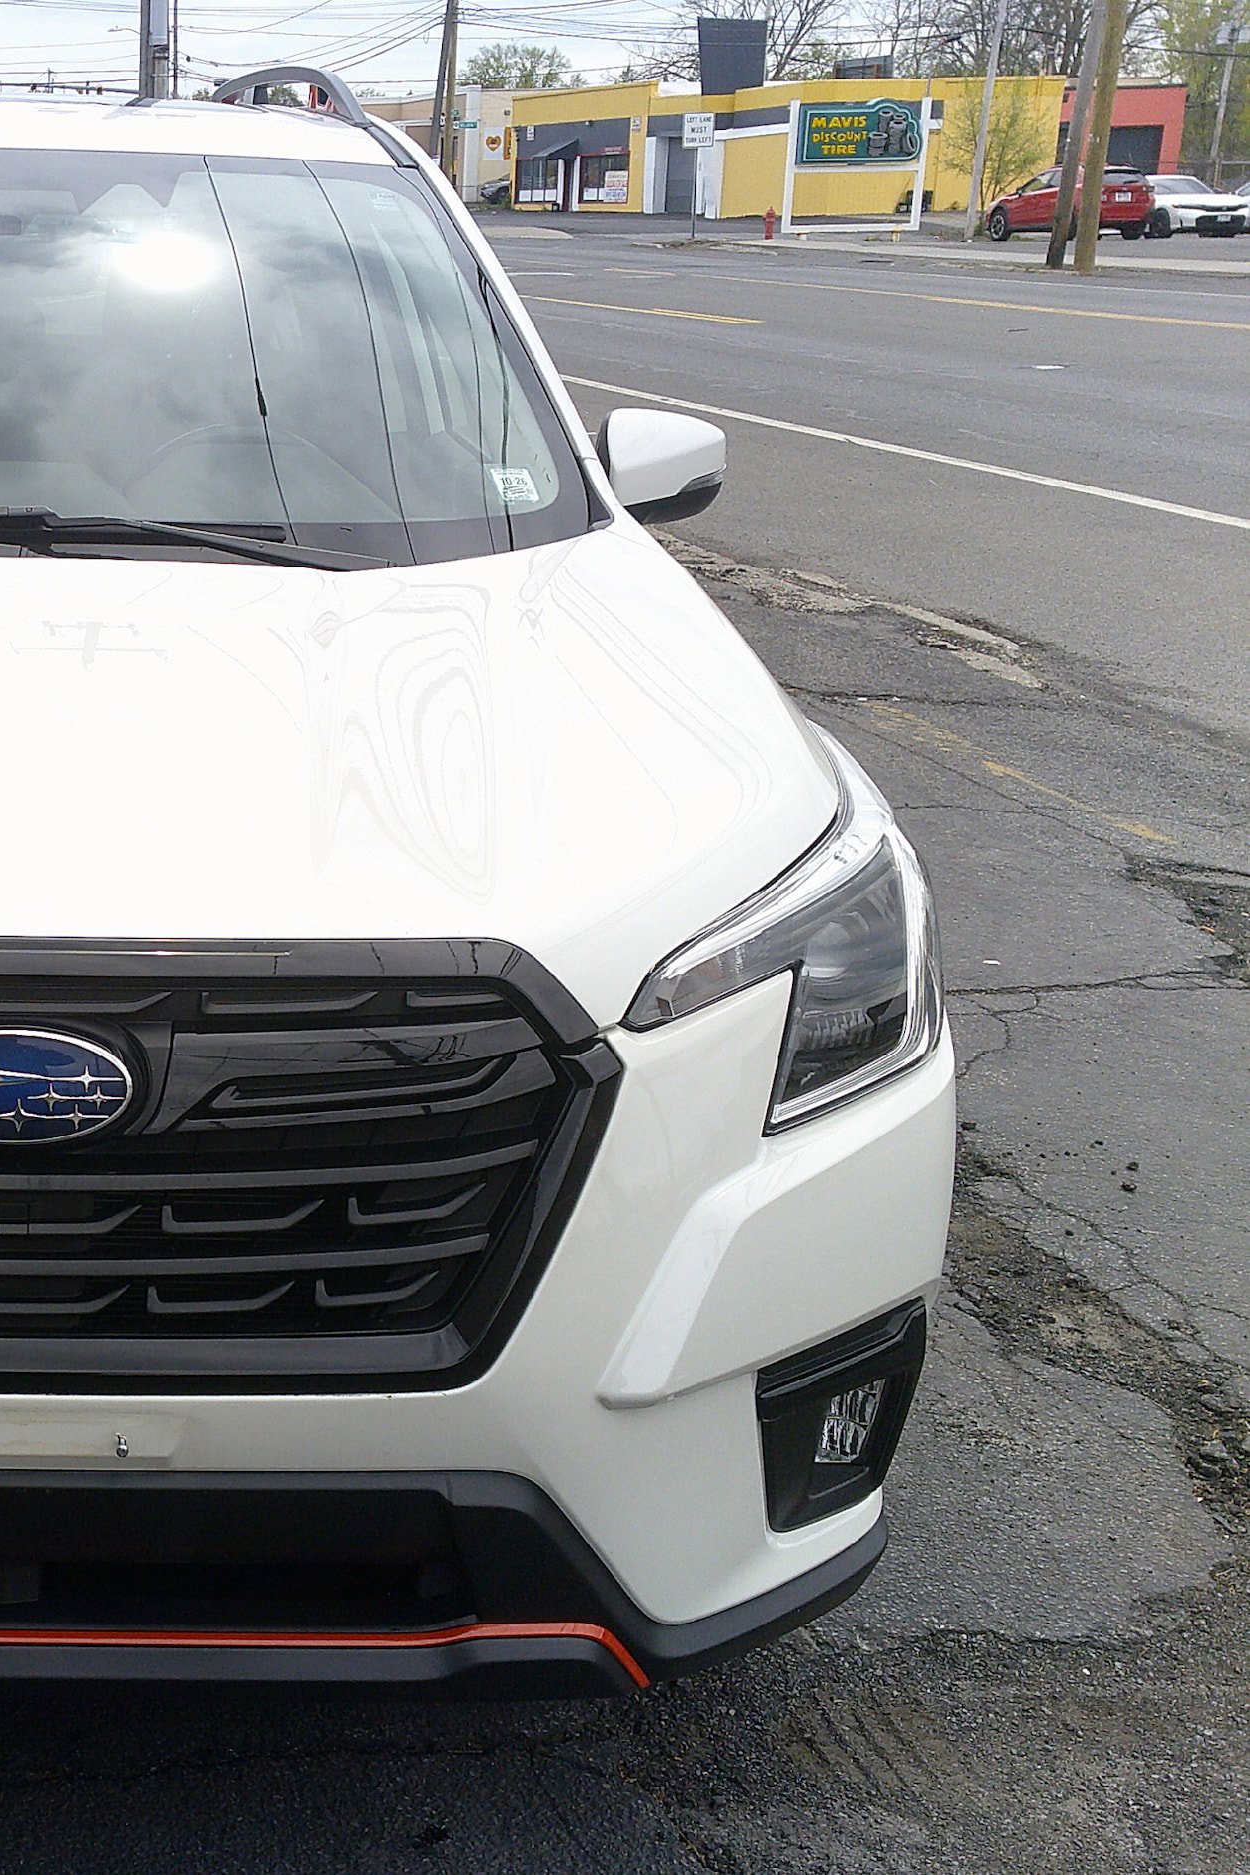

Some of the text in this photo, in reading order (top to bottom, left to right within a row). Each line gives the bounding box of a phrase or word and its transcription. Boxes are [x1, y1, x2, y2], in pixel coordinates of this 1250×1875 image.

[811, 115, 867, 129] MAVIS
[691, 126, 707, 134] MUST
[812, 131, 868, 143] DISCOUNT
[821, 145, 857, 155] TIRE
